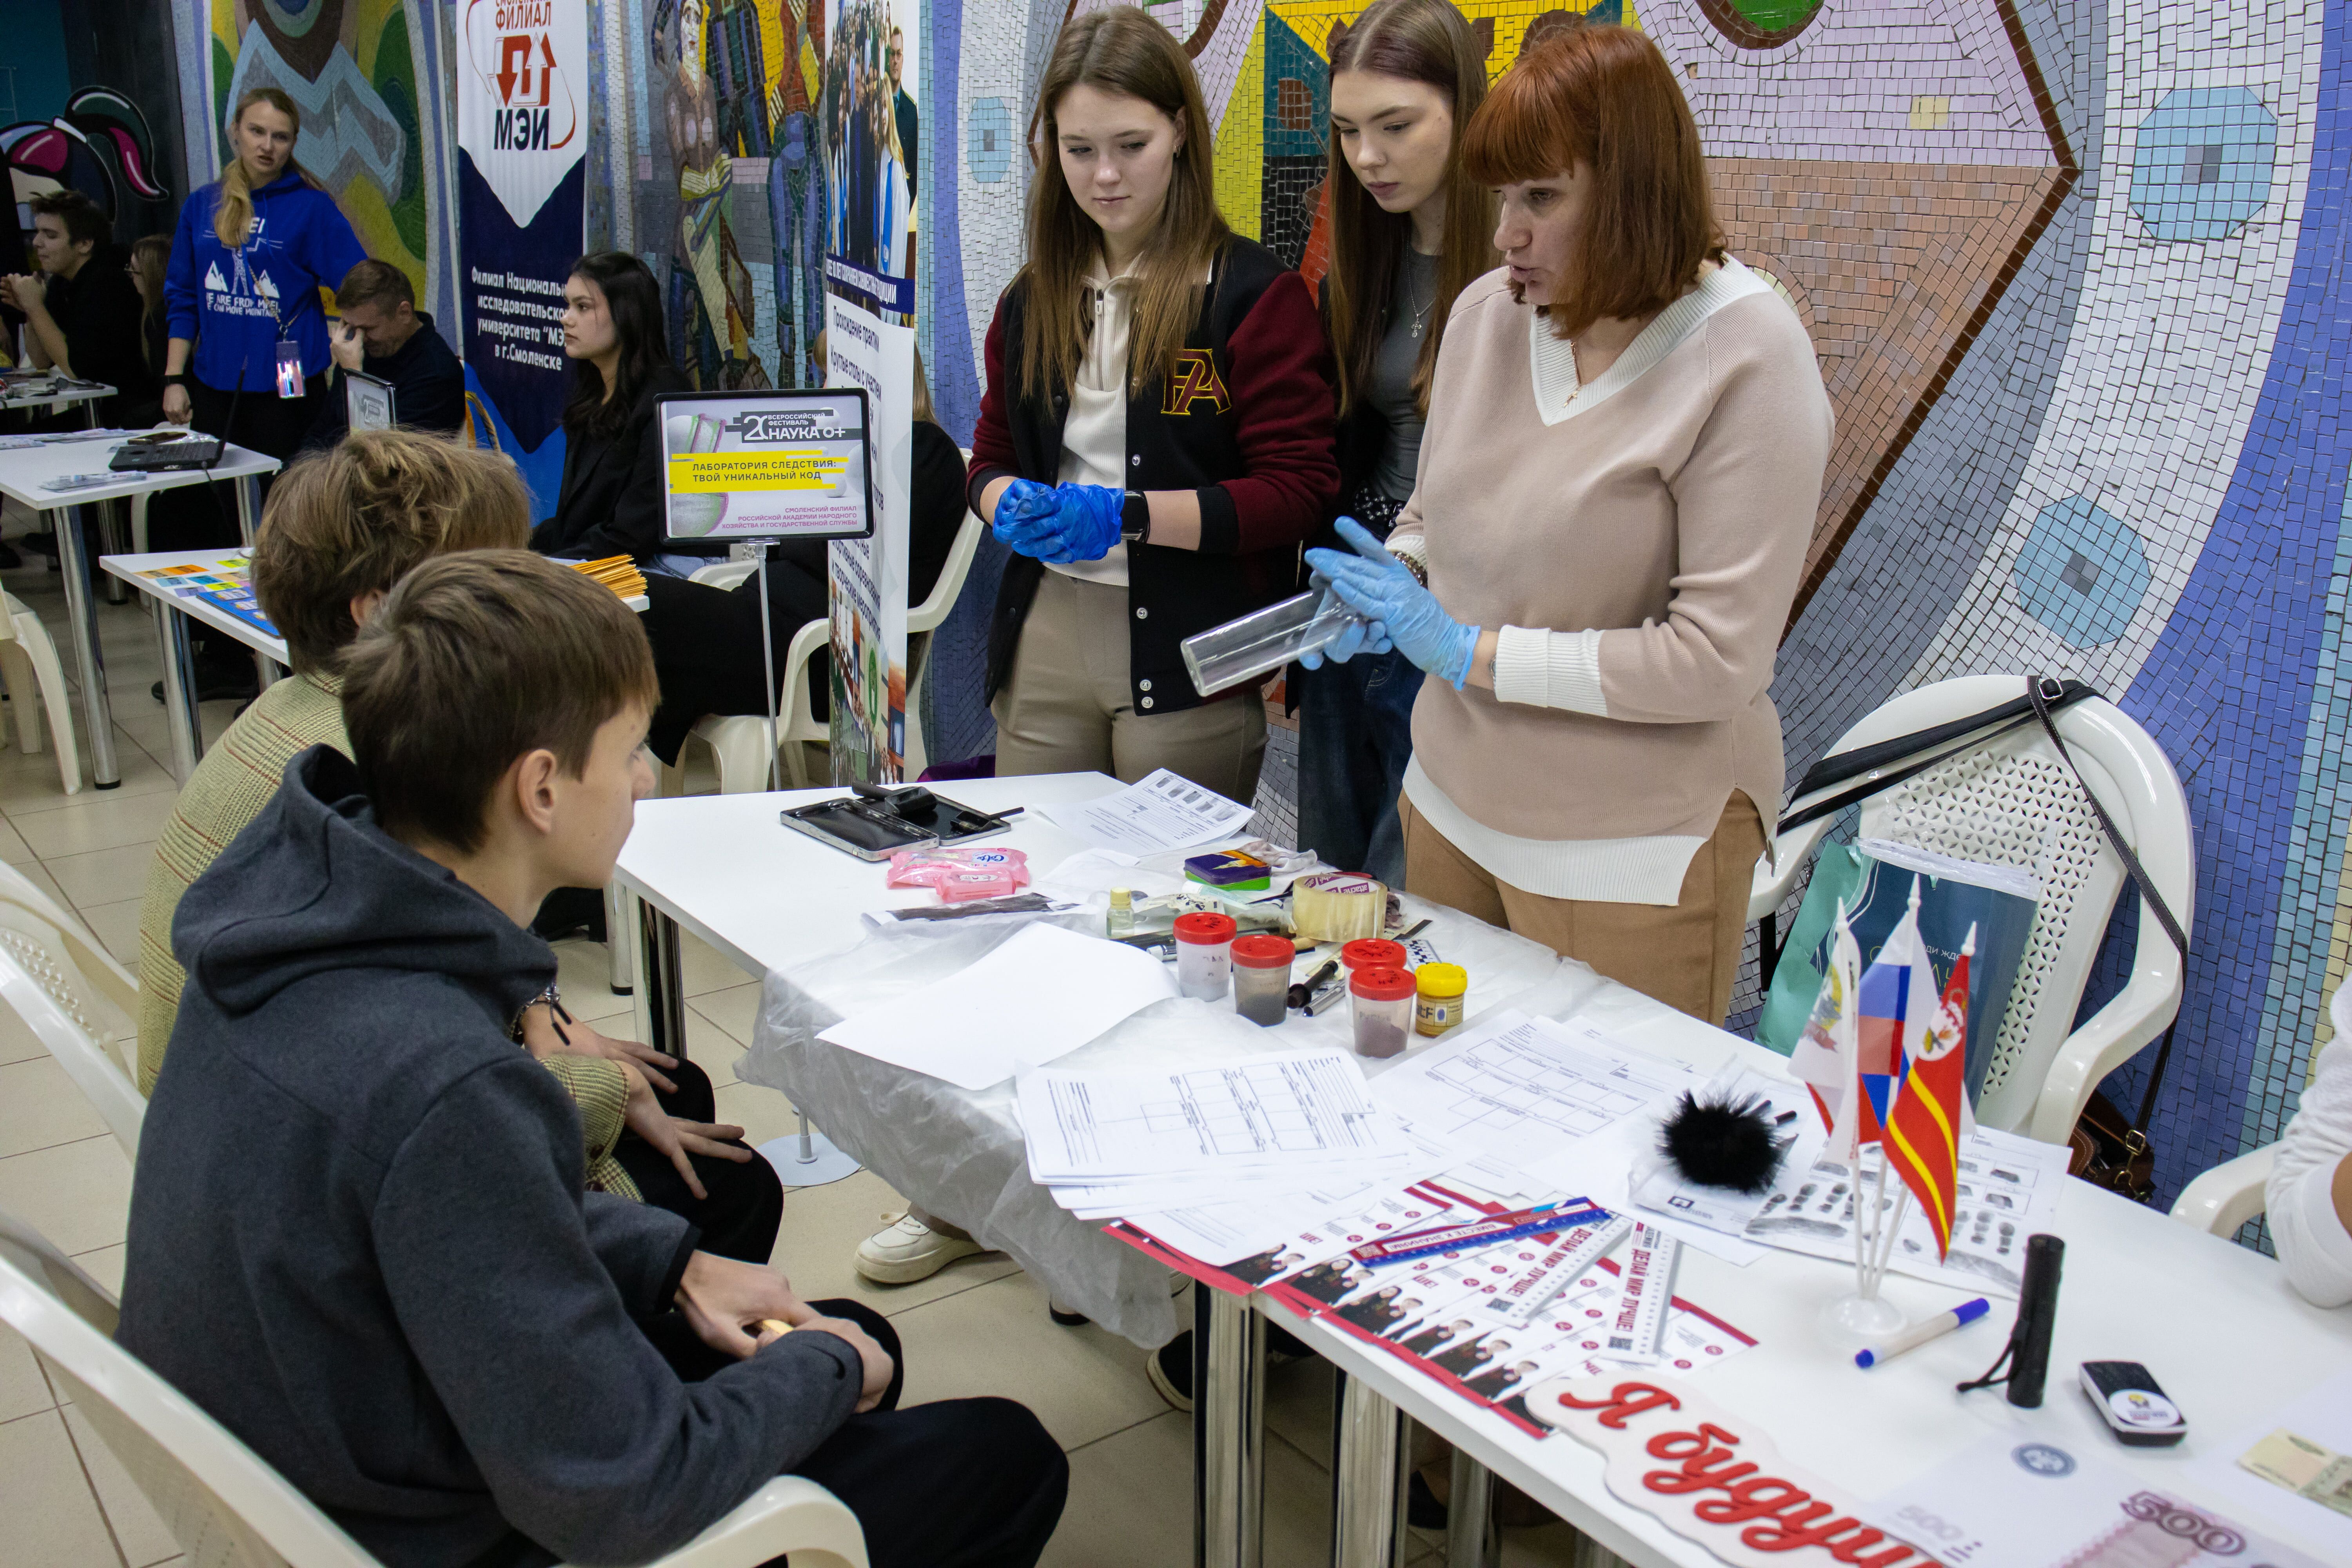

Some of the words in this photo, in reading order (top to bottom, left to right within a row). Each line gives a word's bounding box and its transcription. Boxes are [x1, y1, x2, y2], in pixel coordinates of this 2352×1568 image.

[495, 1, 551, 31] ФИЛИАЛ
[494, 108, 549, 151] МЭИ
[472, 266, 504, 288] Филиал
[216, 294, 231, 306] ARE
[477, 318, 540, 341] университета
[833, 305, 862, 341] Прохождение
[495, 344, 500, 357] в
[831, 344, 848, 374] Круглые
[768, 428, 820, 440] НАУКА
[692, 462, 768, 471] ЛАБОРАТОРИЯ
[771, 460, 836, 469] СЛЕДСТВИЯ:
[693, 472, 720, 483] ТВОЙ
[724, 470, 796, 481] УНИКАЛЬНЫЙ
[800, 471, 821, 480] КОД
[766, 519, 827, 528] ГОСУДАРСТВЕННОЙ
[1457, 1224, 1497, 1235] ВМЕСТЕ
[1558, 1227, 1593, 1254] ДЕЛАЙ
[1541, 1251, 1567, 1269] МИР
[1629, 1248, 1651, 1277] ДЕЛАЙ
[1505, 1267, 1548, 1297] ЛУЧШЕ
[1625, 1278, 1644, 1296] МИР
[1615, 1297, 1640, 1332] ЛУЧШЕ
[1558, 1381, 1681, 1430] Я
[2120, 1490, 2247, 1555] 500
